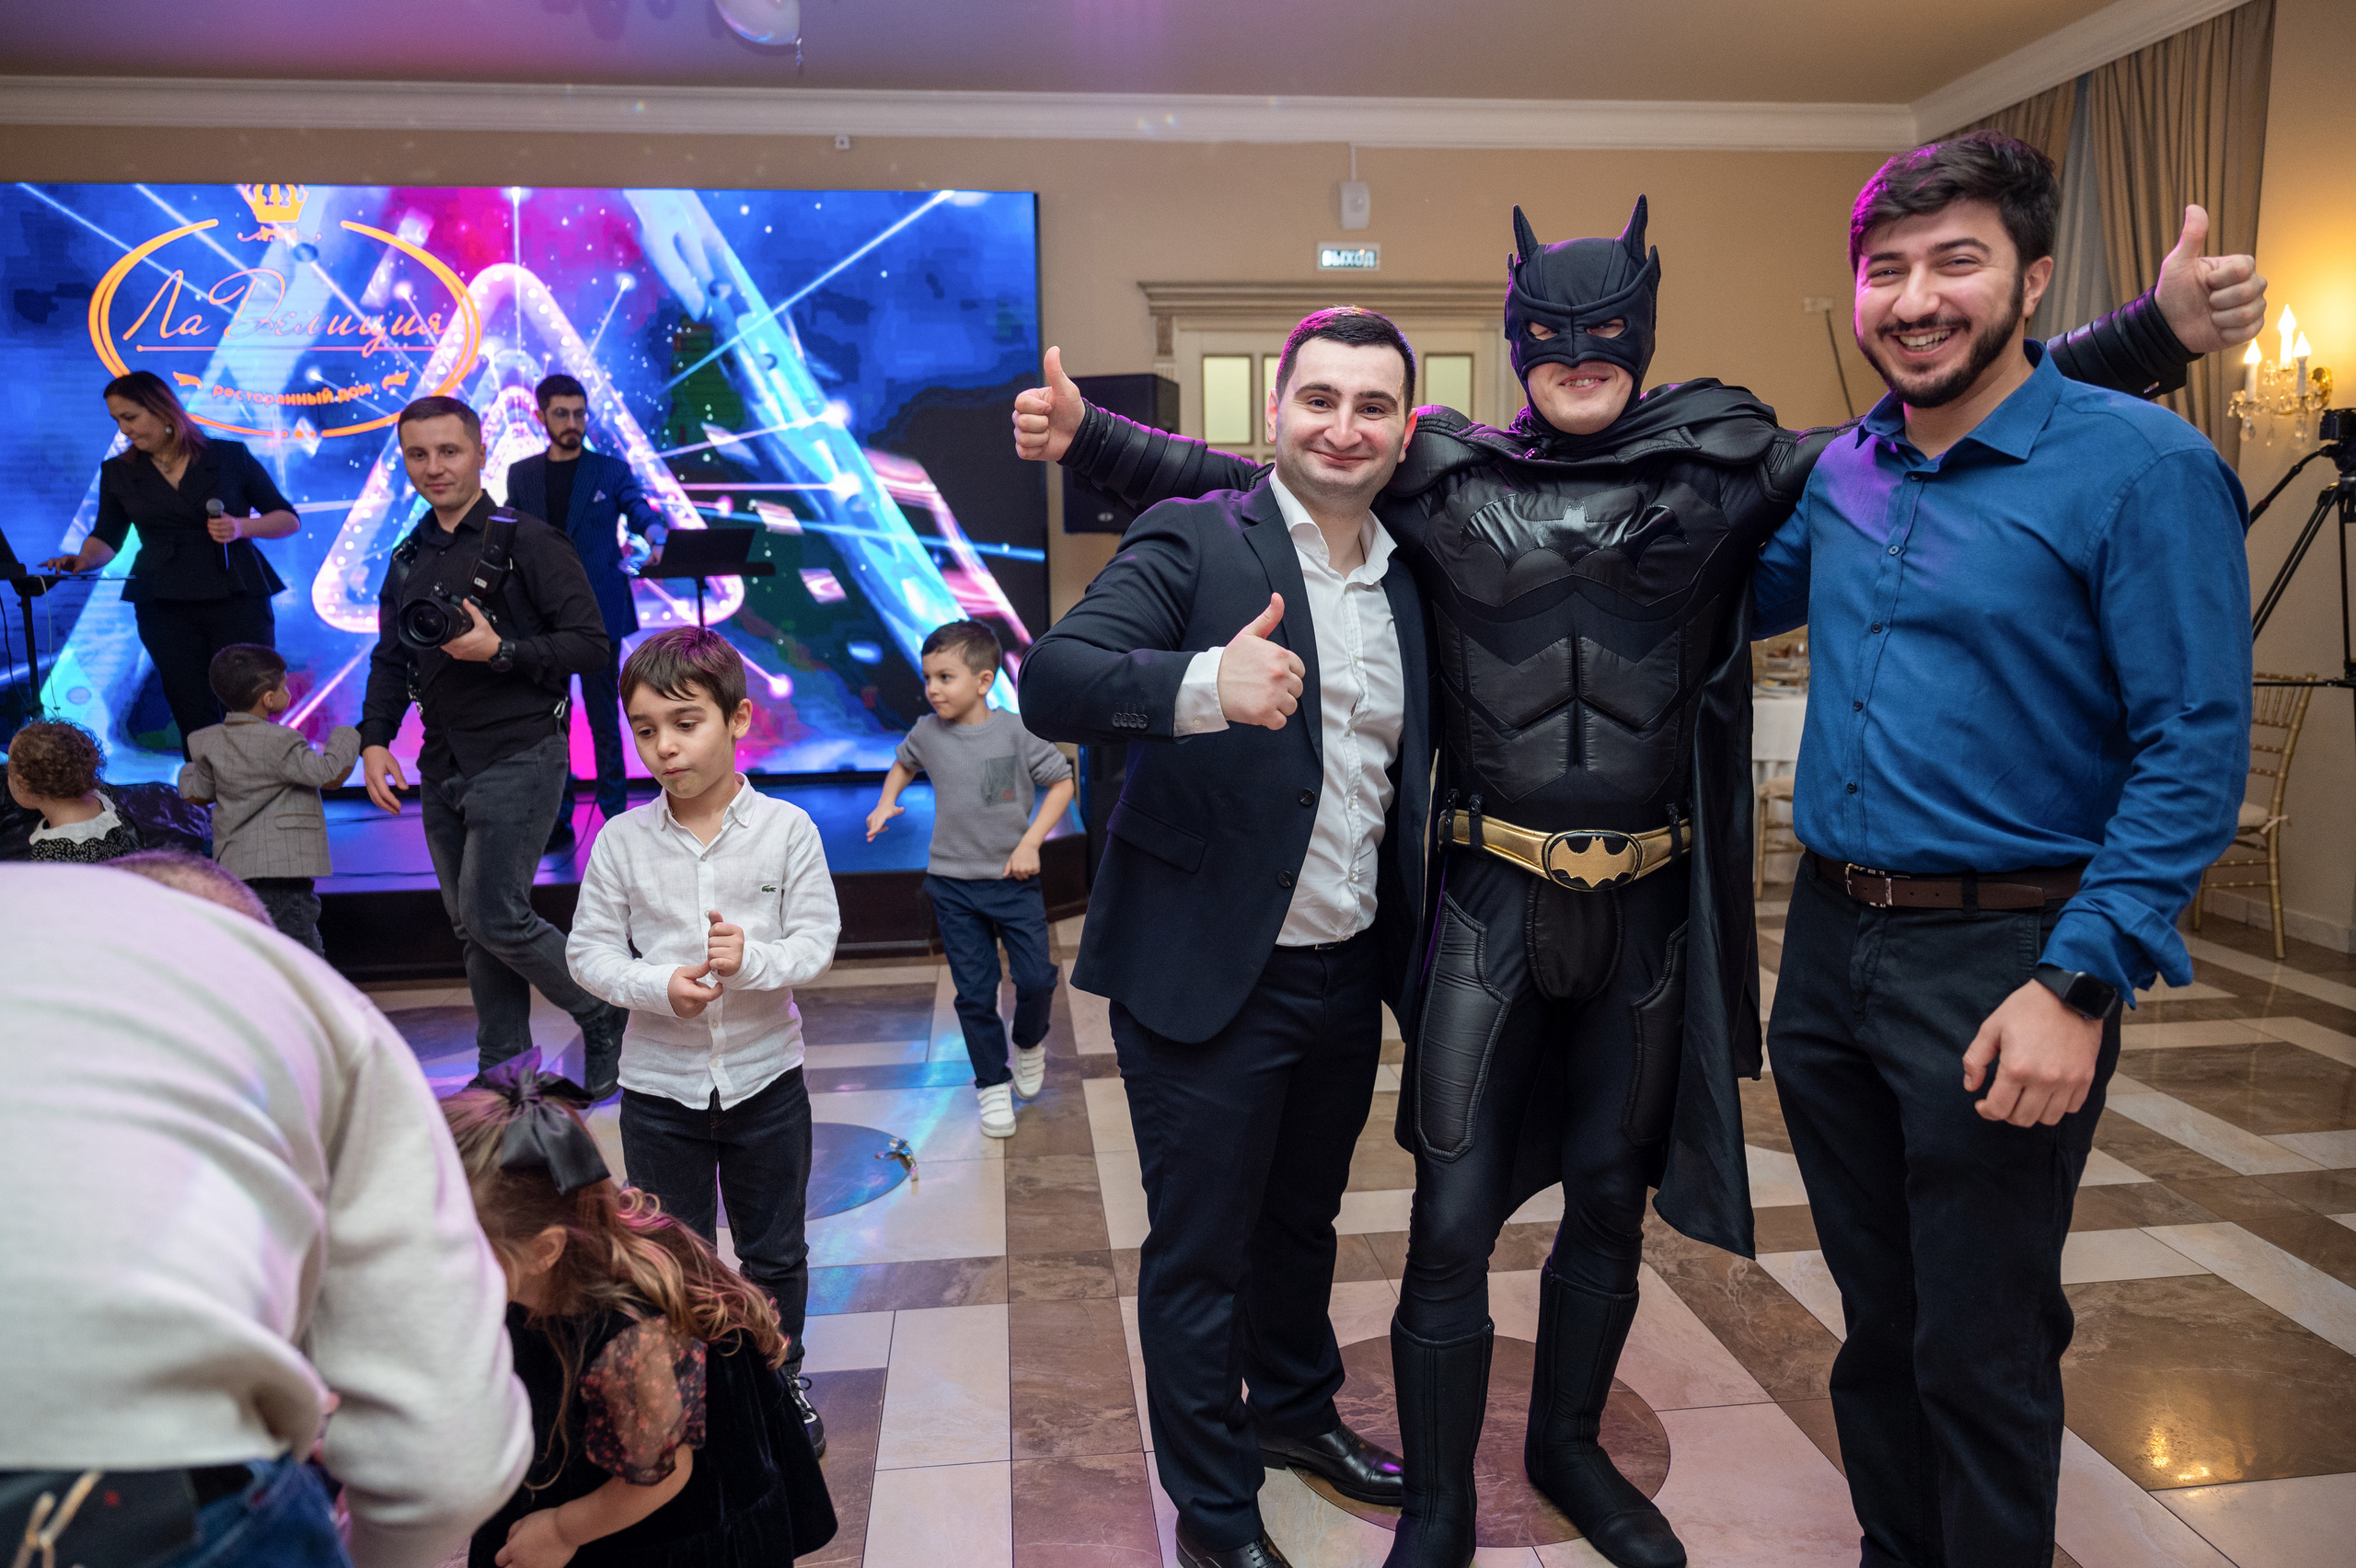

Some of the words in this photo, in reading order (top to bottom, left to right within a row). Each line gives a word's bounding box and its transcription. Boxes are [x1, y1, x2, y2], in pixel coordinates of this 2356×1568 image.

[122, 269, 211, 341] Ла
[213, 385, 334, 406] ресторанный
[336, 383, 373, 403] дом
